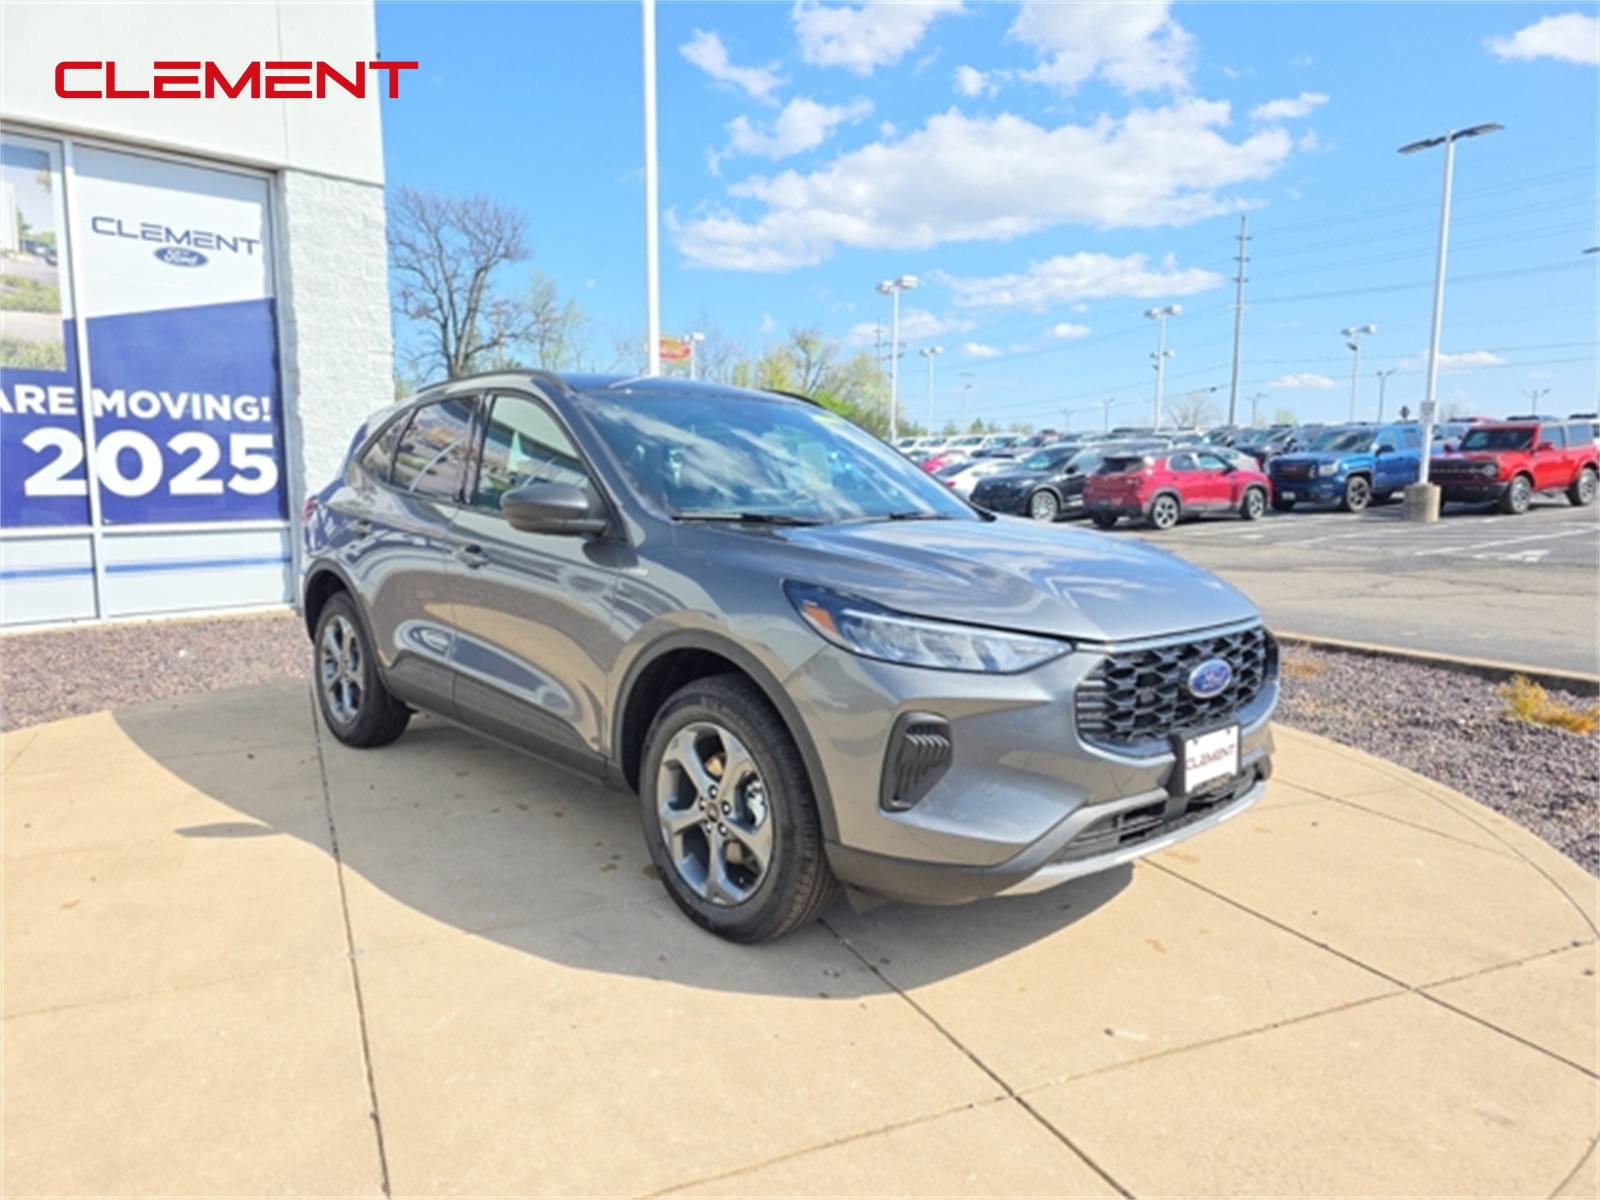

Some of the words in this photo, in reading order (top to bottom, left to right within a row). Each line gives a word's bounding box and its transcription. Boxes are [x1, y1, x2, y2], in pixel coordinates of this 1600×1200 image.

[91, 215, 260, 256] CLEMENT
[92, 388, 272, 423] MOVING!
[21, 426, 279, 498] 2025
